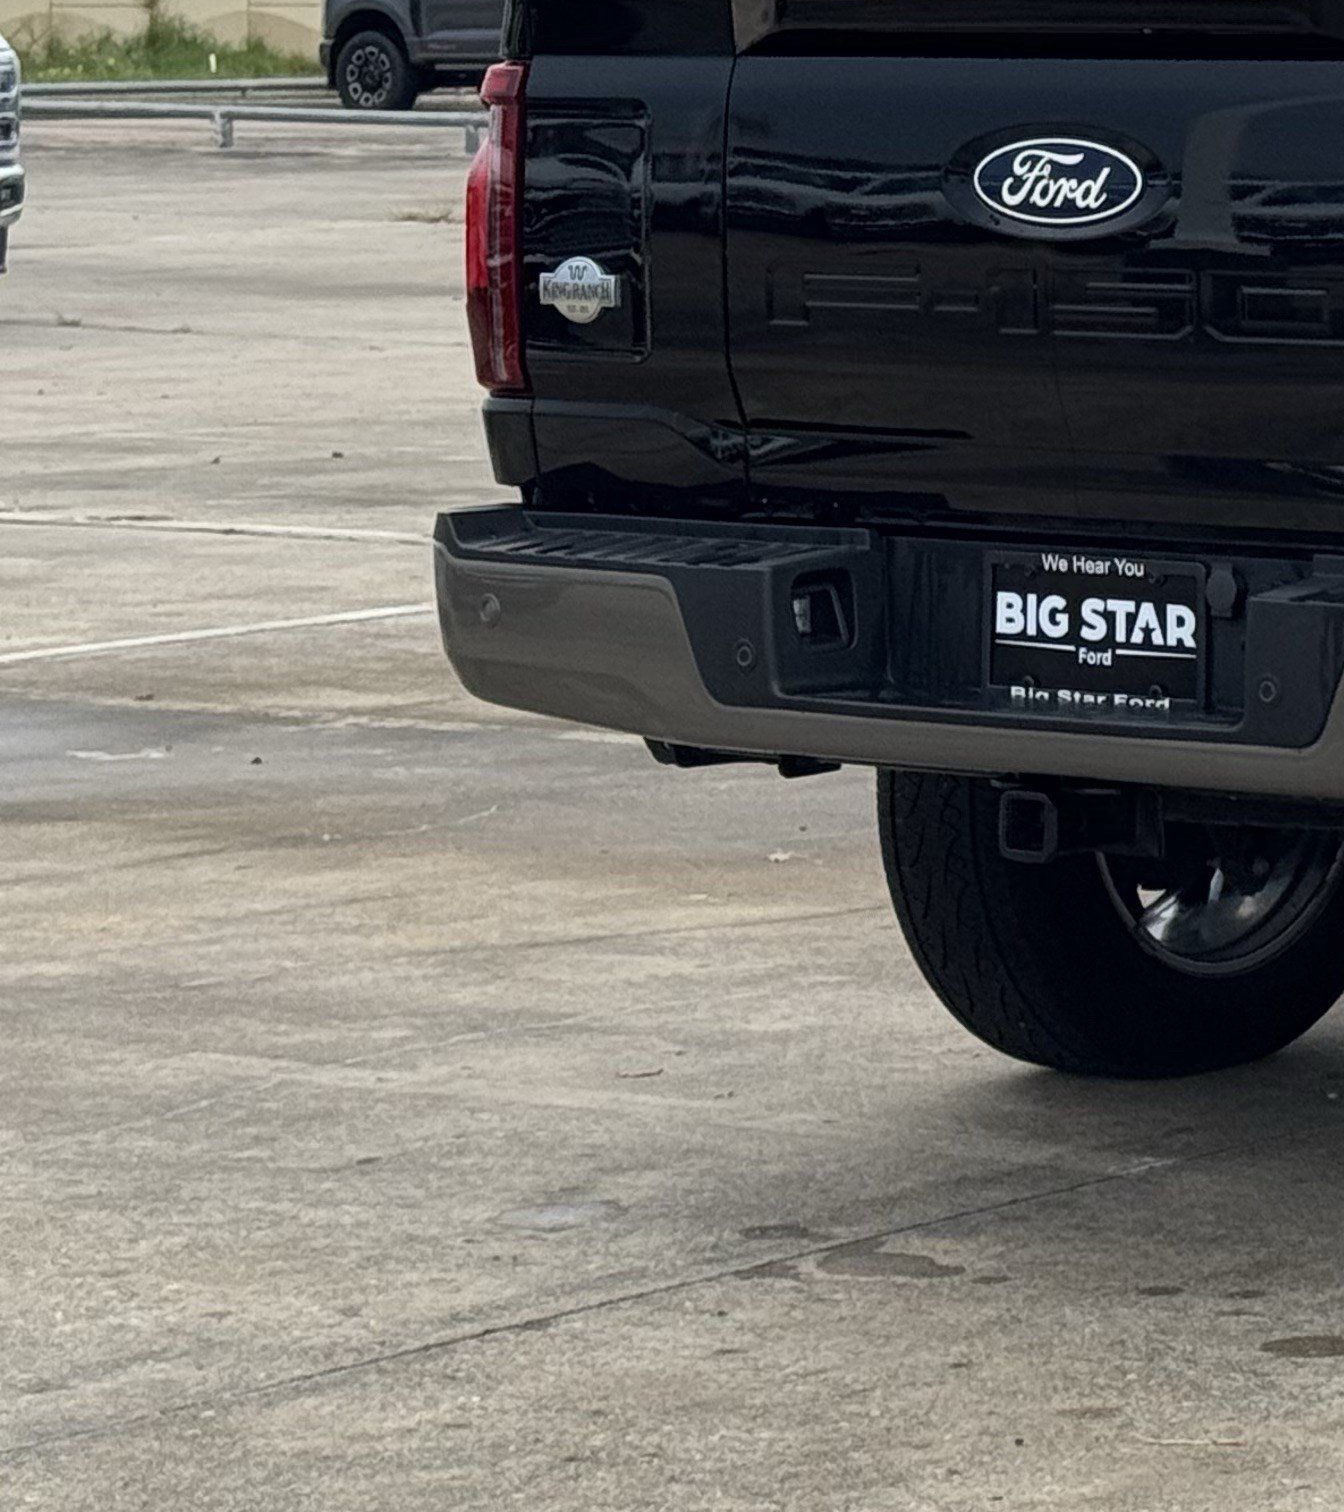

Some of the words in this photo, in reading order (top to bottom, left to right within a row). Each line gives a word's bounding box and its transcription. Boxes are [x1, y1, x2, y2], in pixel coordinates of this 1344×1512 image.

[1002, 149, 1111, 209] Ford
[571, 281, 610, 301] RANCH
[1042, 553, 1069, 571] We
[1073, 556, 1111, 575] Hear
[1114, 558, 1145, 577] You
[995, 591, 1069, 638] BIG
[1080, 598, 1196, 648] STAR
[1078, 648, 1112, 666] Ford
